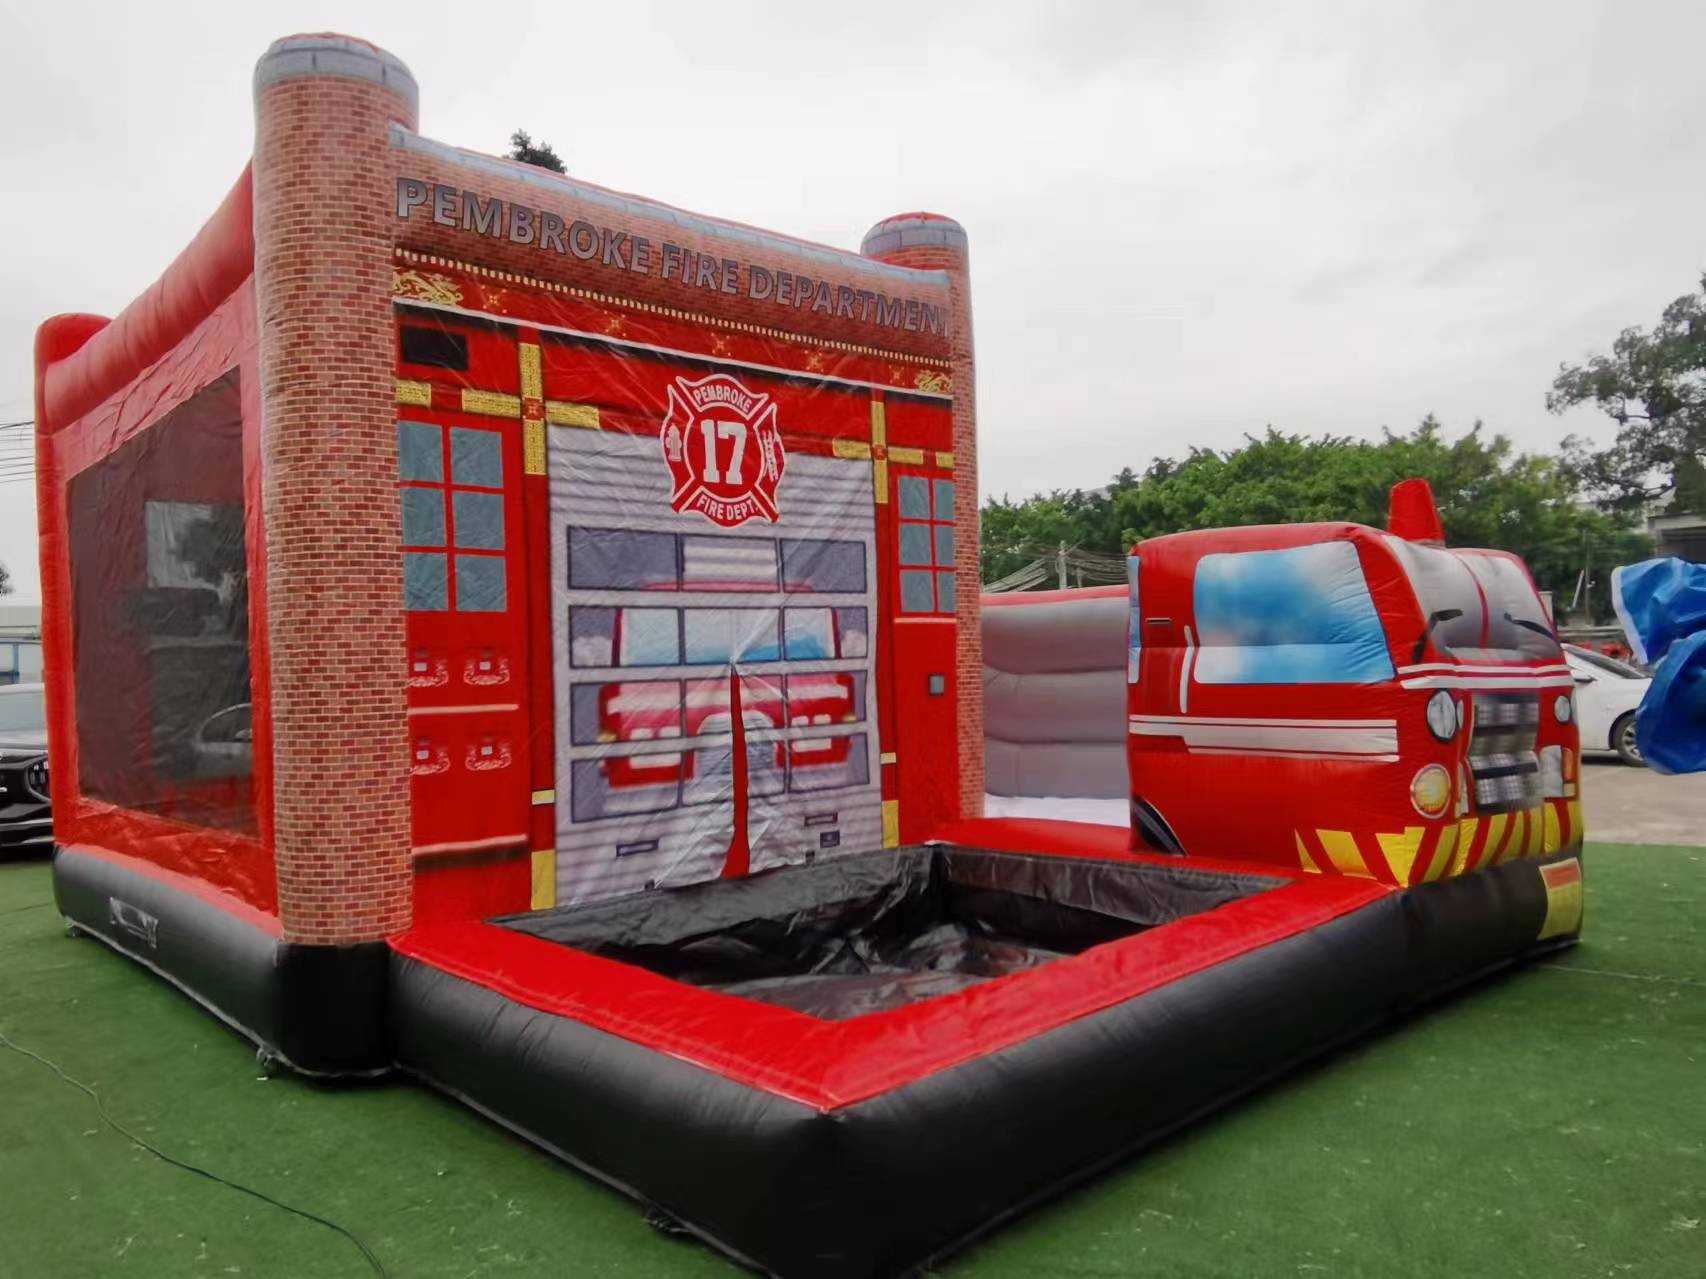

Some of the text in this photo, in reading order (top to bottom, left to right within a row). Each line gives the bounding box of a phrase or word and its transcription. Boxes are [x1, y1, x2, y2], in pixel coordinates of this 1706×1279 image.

[396, 177, 651, 274] PEMBROKE
[661, 242, 739, 294] FIRE
[693, 384, 753, 413] PEMBROKE
[701, 419, 747, 485] 17
[696, 494, 725, 520] FIRE
